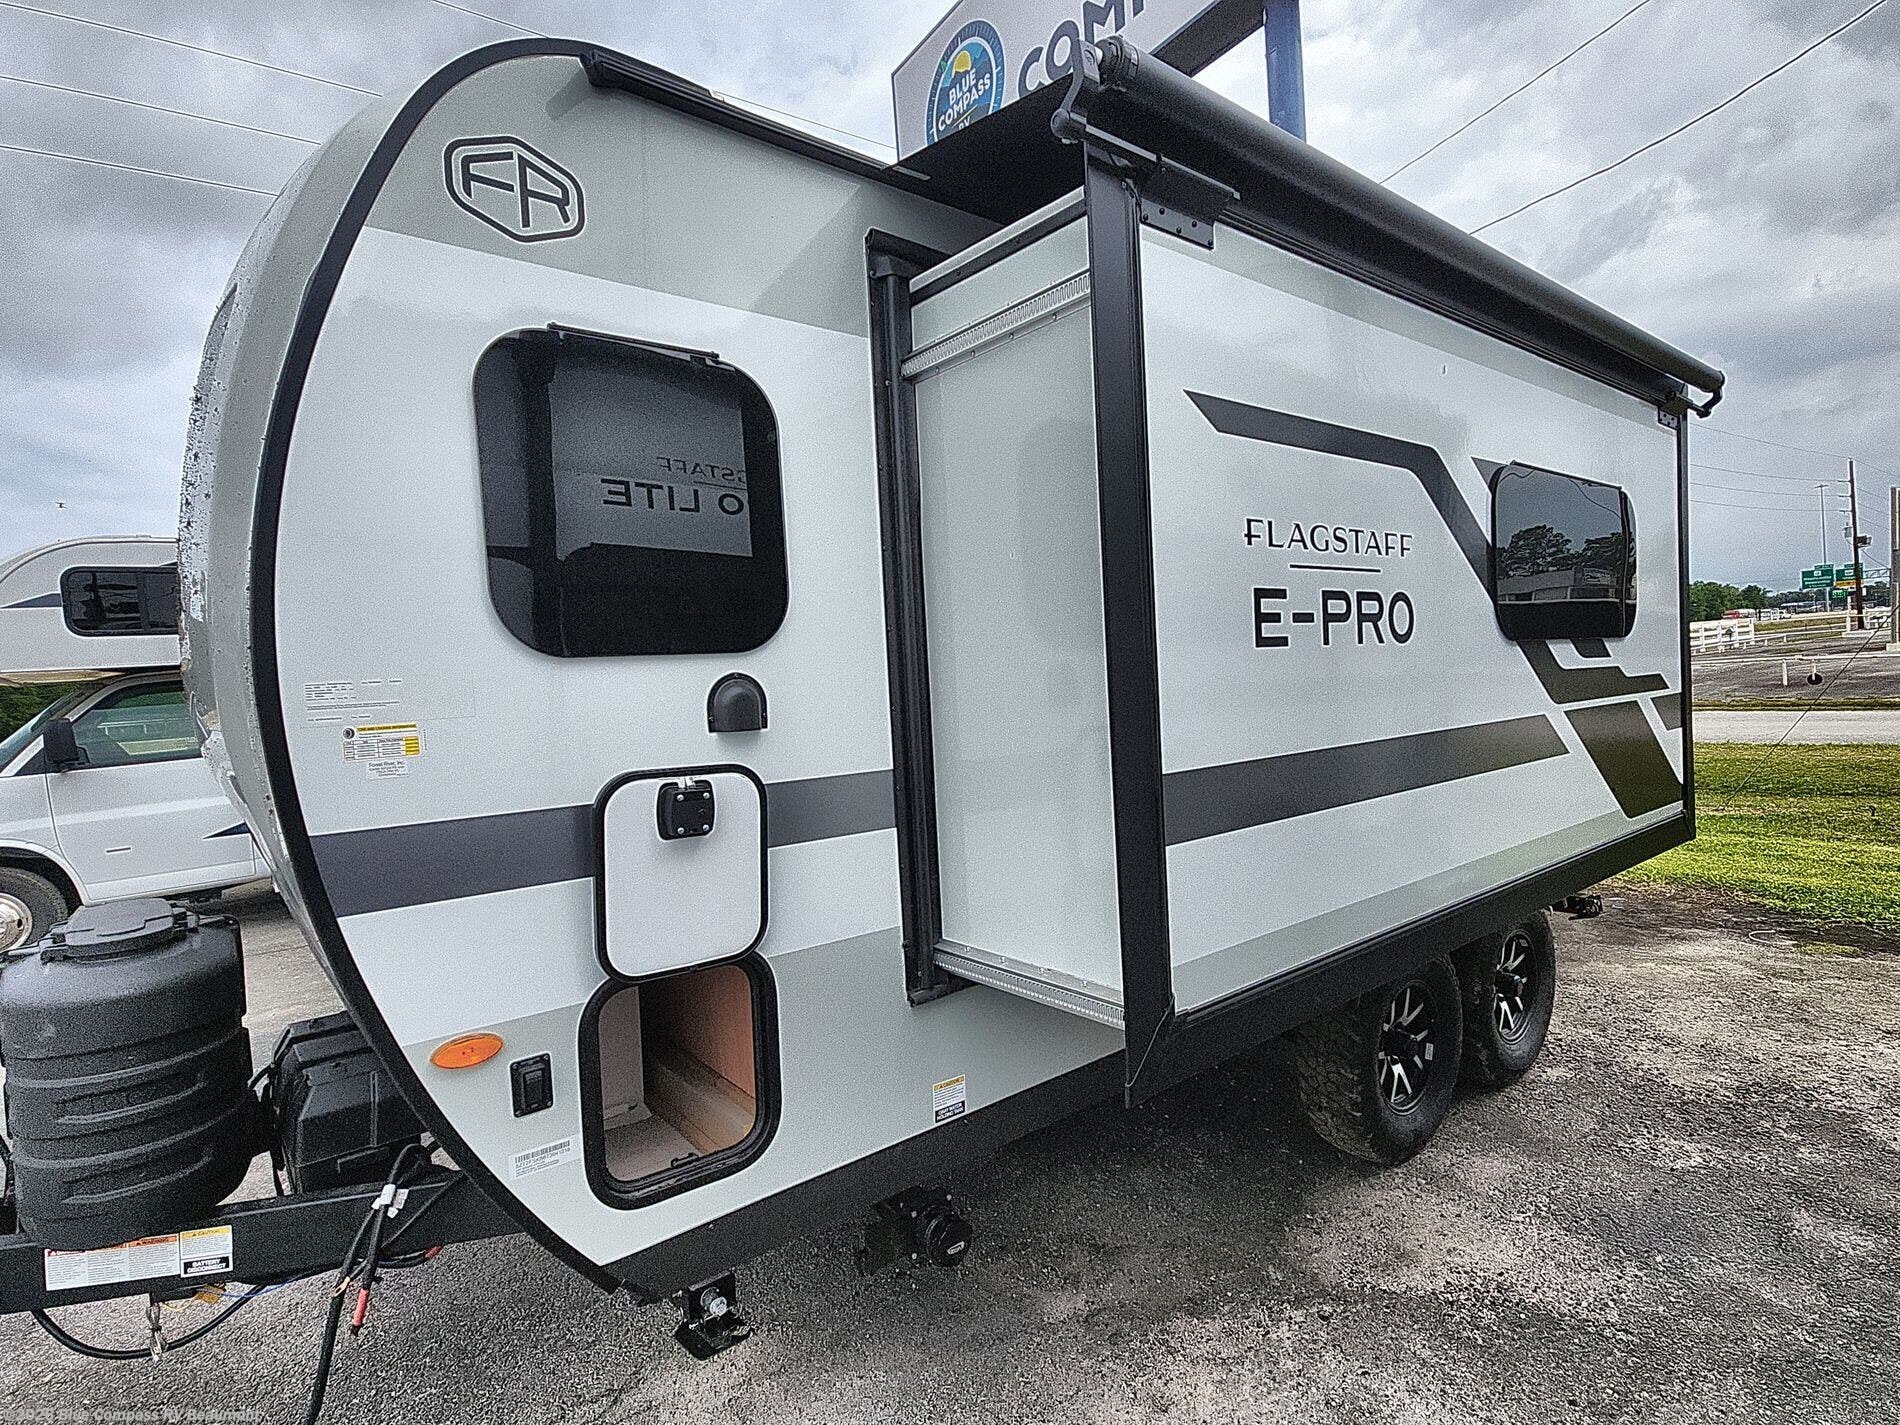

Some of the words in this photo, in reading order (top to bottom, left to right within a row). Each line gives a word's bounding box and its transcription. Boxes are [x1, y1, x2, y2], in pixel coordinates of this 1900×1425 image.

[1018, 0, 1144, 97] COM
[938, 73, 991, 131] COMPASS
[949, 68, 977, 105] BLUE
[460, 150, 571, 229] FR
[1244, 518, 1413, 557] FLAGSTAFF
[1253, 587, 1415, 648] E-PRO
[186, 1262, 227, 1273] DISCONNECT
[191, 1258, 221, 1268] BATTERY
